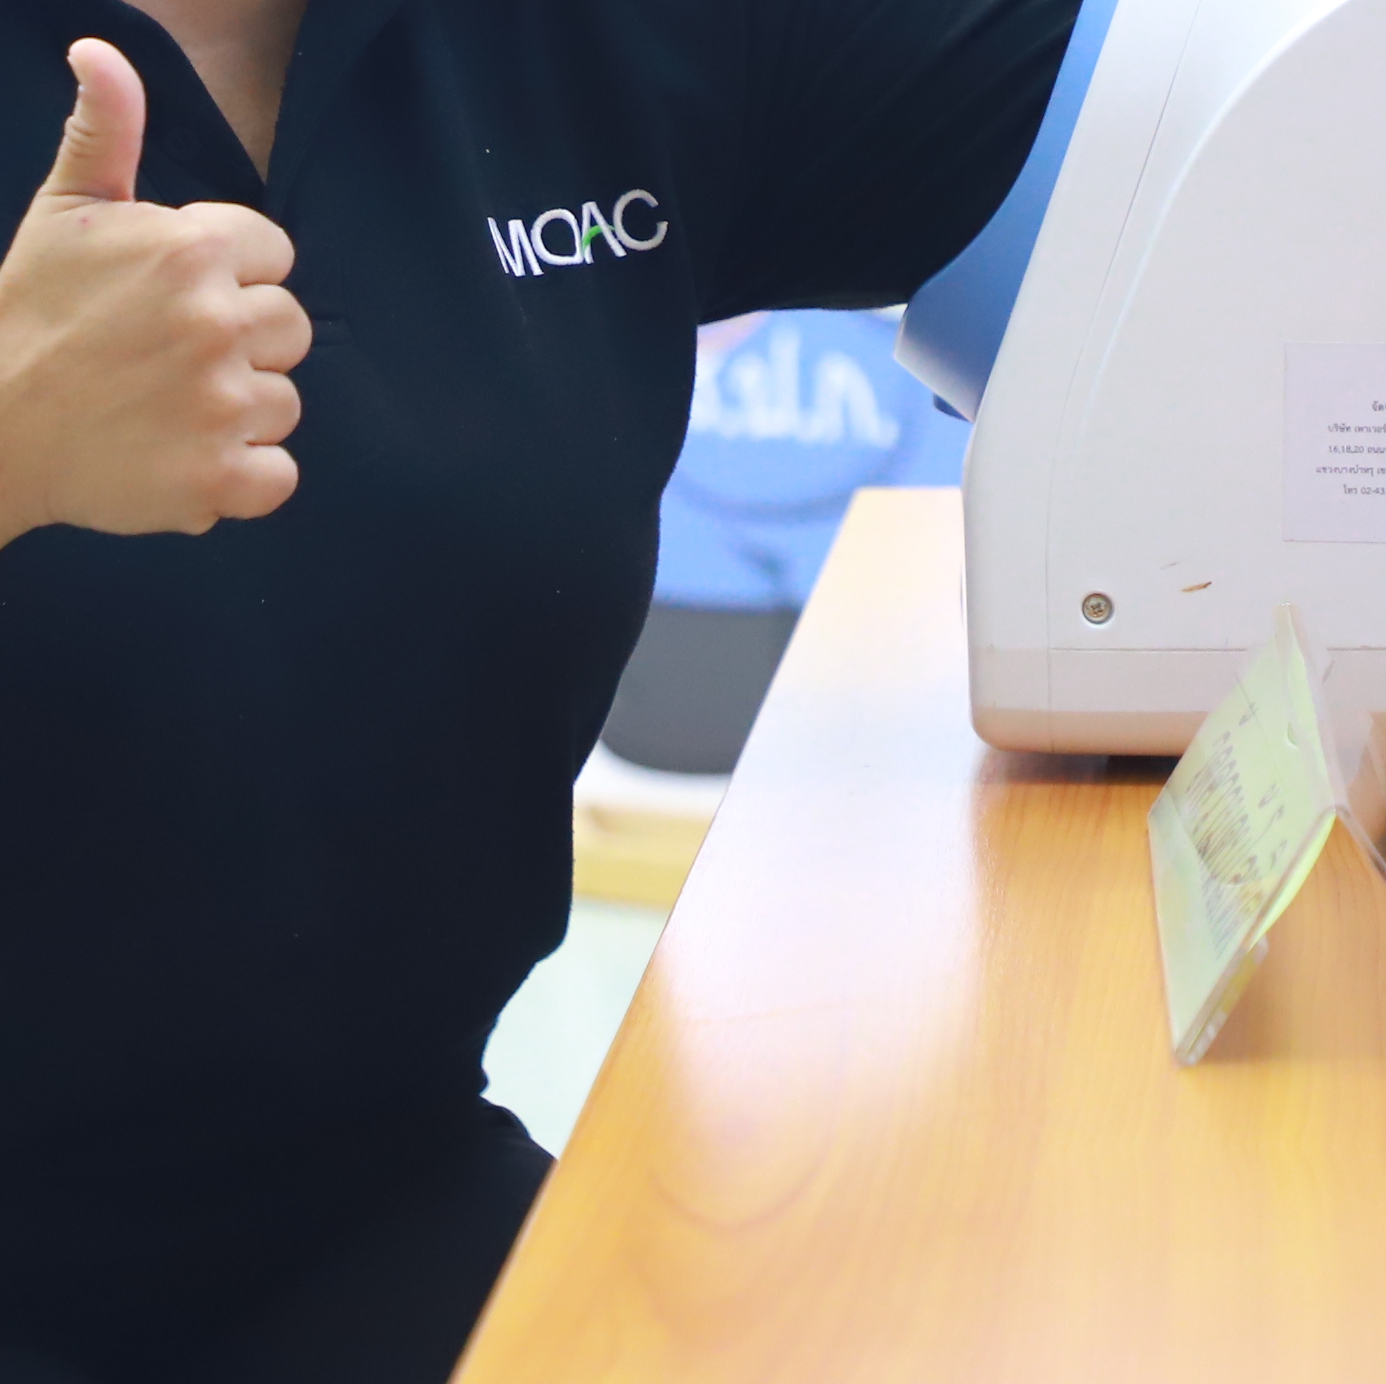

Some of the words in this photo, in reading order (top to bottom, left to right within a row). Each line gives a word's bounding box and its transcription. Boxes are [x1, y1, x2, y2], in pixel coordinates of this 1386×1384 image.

[487, 188, 669, 277] MOAC
[1327, 423, 1351, 432] บริษัท
